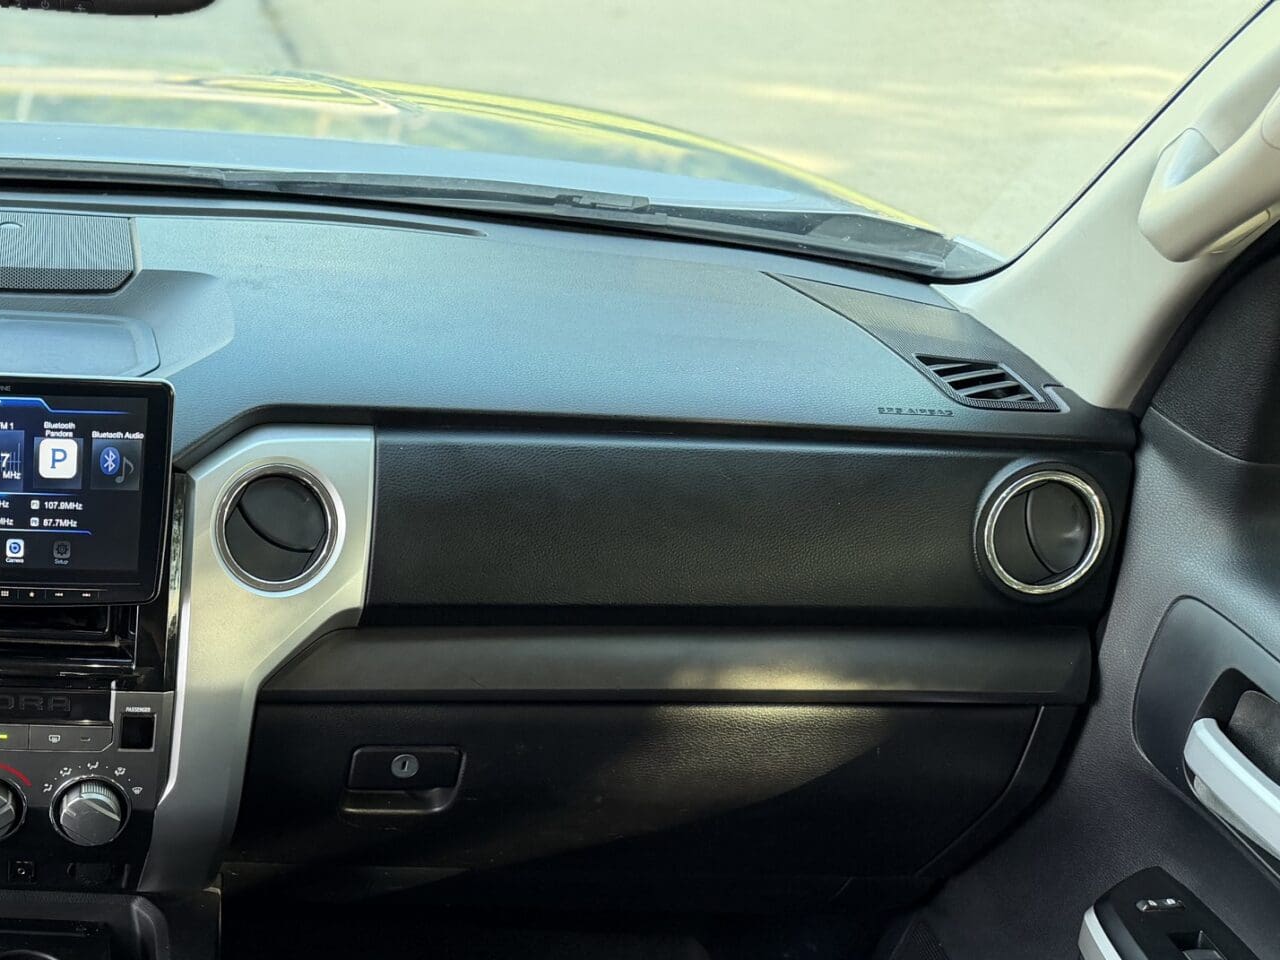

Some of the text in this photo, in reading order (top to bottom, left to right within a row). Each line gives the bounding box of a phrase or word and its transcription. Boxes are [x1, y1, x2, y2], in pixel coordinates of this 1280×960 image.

[43, 421, 75, 430] Bluetooth
[45, 430, 74, 438] Pandora
[91, 430, 144, 440] Bluetooth Audio
[2, 471, 22, 480] MHz
